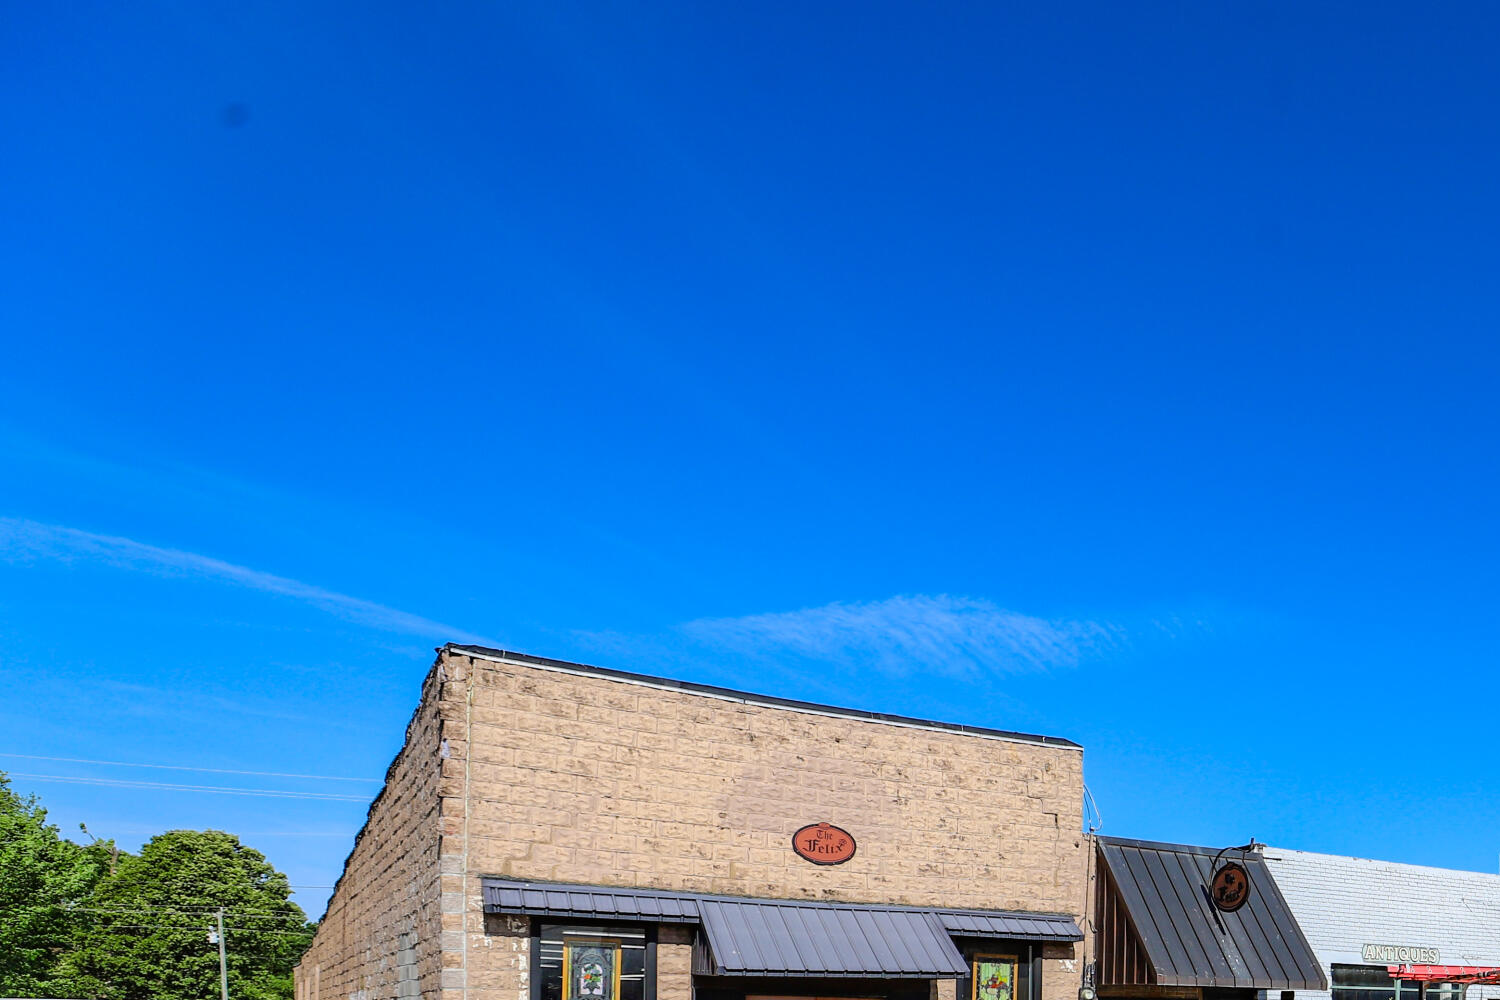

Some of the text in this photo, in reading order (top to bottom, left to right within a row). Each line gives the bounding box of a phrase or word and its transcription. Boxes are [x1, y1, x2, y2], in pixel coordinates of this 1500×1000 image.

[816, 829, 833, 840] The
[802, 838, 848, 855] Felix
[1363, 944, 1438, 963] ANTIQUES
